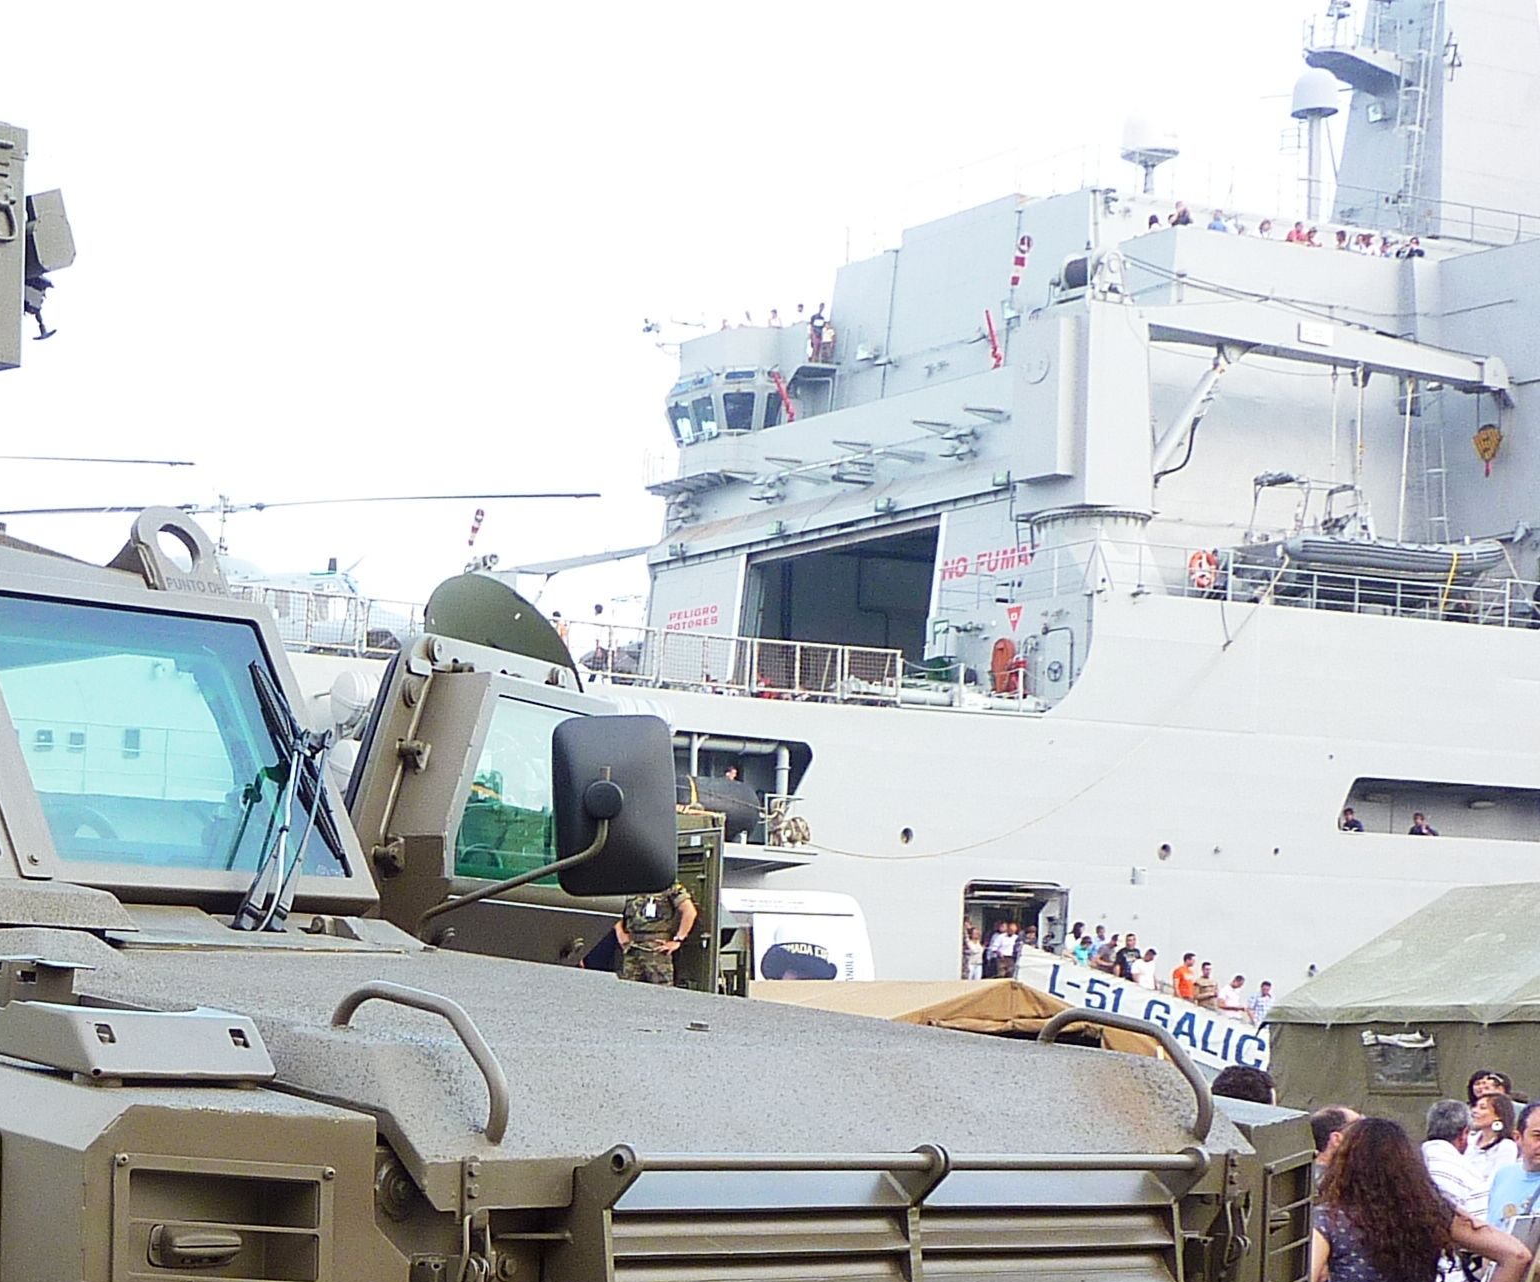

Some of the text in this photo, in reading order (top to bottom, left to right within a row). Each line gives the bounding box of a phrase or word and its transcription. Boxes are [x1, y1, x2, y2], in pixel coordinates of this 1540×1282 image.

[941, 557, 968, 580] NO
[165, 577, 206, 593] PUNTO
[669, 605, 719, 621] PELIGRO
[1048, 963, 1125, 1014] L-51
